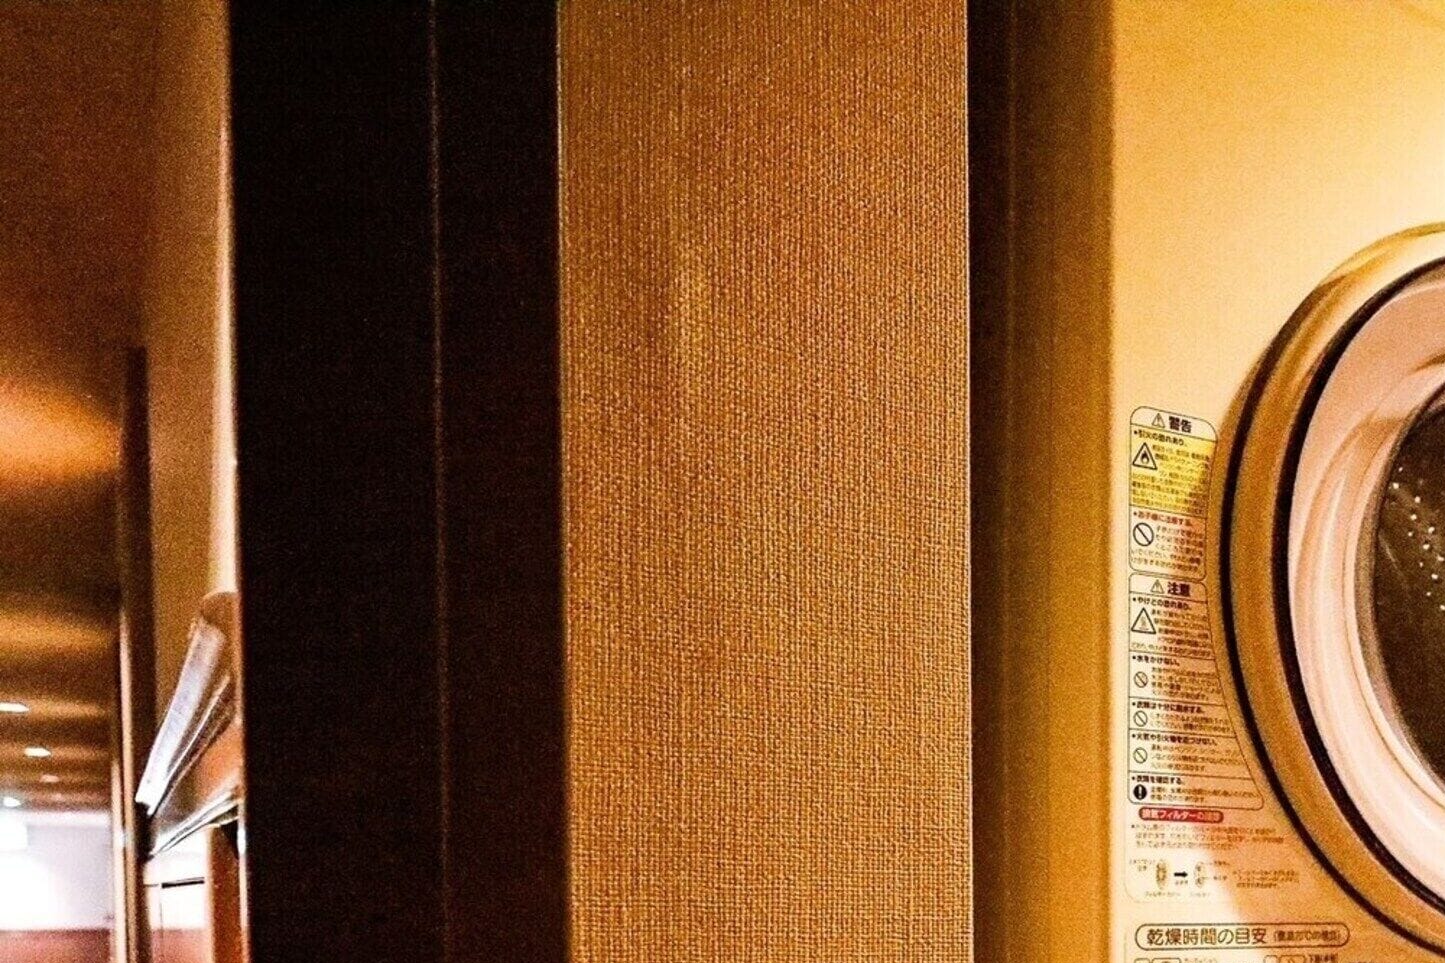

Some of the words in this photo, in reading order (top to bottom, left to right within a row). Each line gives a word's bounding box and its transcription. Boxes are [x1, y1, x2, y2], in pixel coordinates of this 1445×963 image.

[1167, 581, 1191, 597] 注意
[1147, 928, 1267, 946] 乾燥時間の目安
